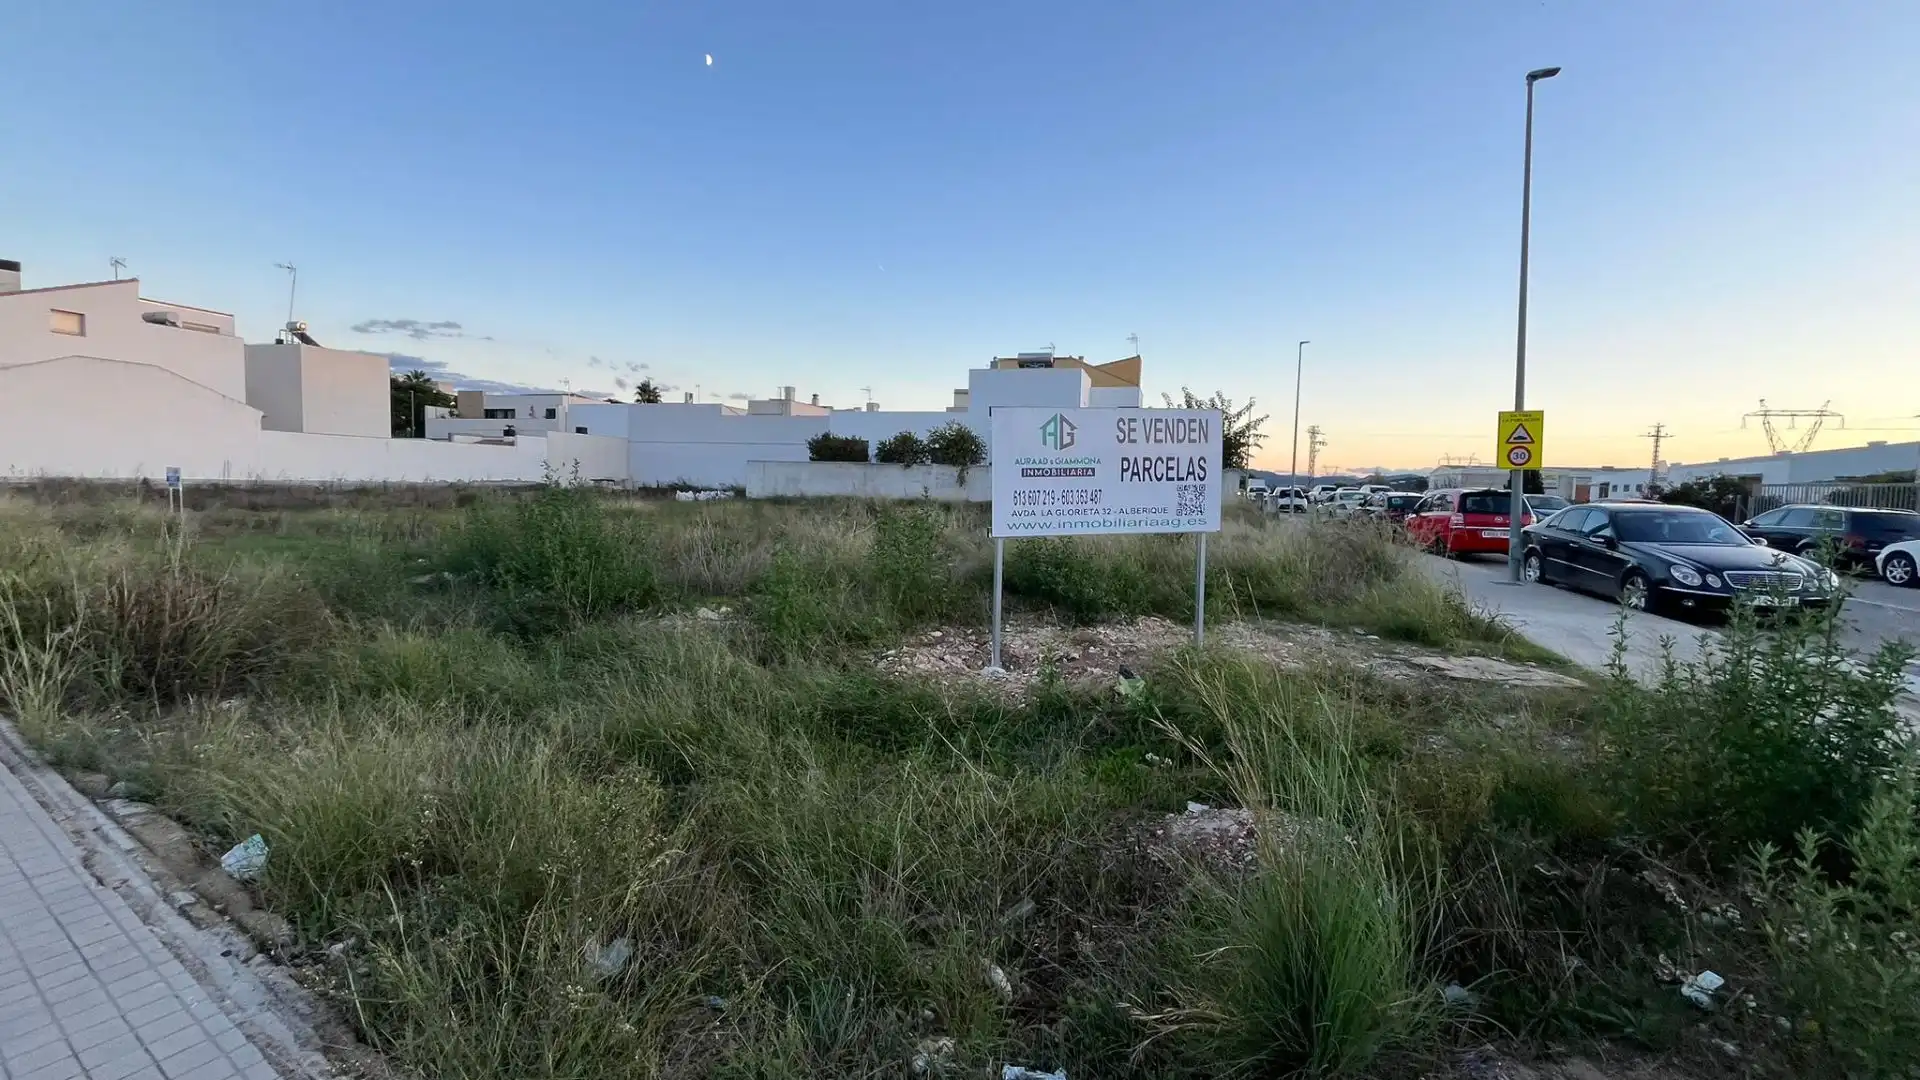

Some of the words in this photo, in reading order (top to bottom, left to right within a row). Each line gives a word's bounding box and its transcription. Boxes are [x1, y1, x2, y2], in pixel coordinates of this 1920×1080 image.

[1116, 417, 1138, 444] SE
[1142, 418, 1209, 444] VENDEN
[1014, 457, 1048, 465] AURAAD
[1055, 457, 1102, 465] GIAMMONA
[1512, 452, 1526, 460] 30
[1023, 468, 1094, 477] INMOBILIARIA
[1121, 456, 1207, 482] PARCELAS
[1013, 490, 1026, 506] 613
[1042, 490, 1055, 505] 219
[1061, 489, 1074, 505] 603
[1075, 489, 1088, 505] 363
[1089, 489, 1102, 505] 487
[1055, 508, 1100, 516] GLORIETA
[1119, 507, 1169, 515] ALBERIQUE
[1007, 517, 1208, 530] www.inmobiliariaag.es
